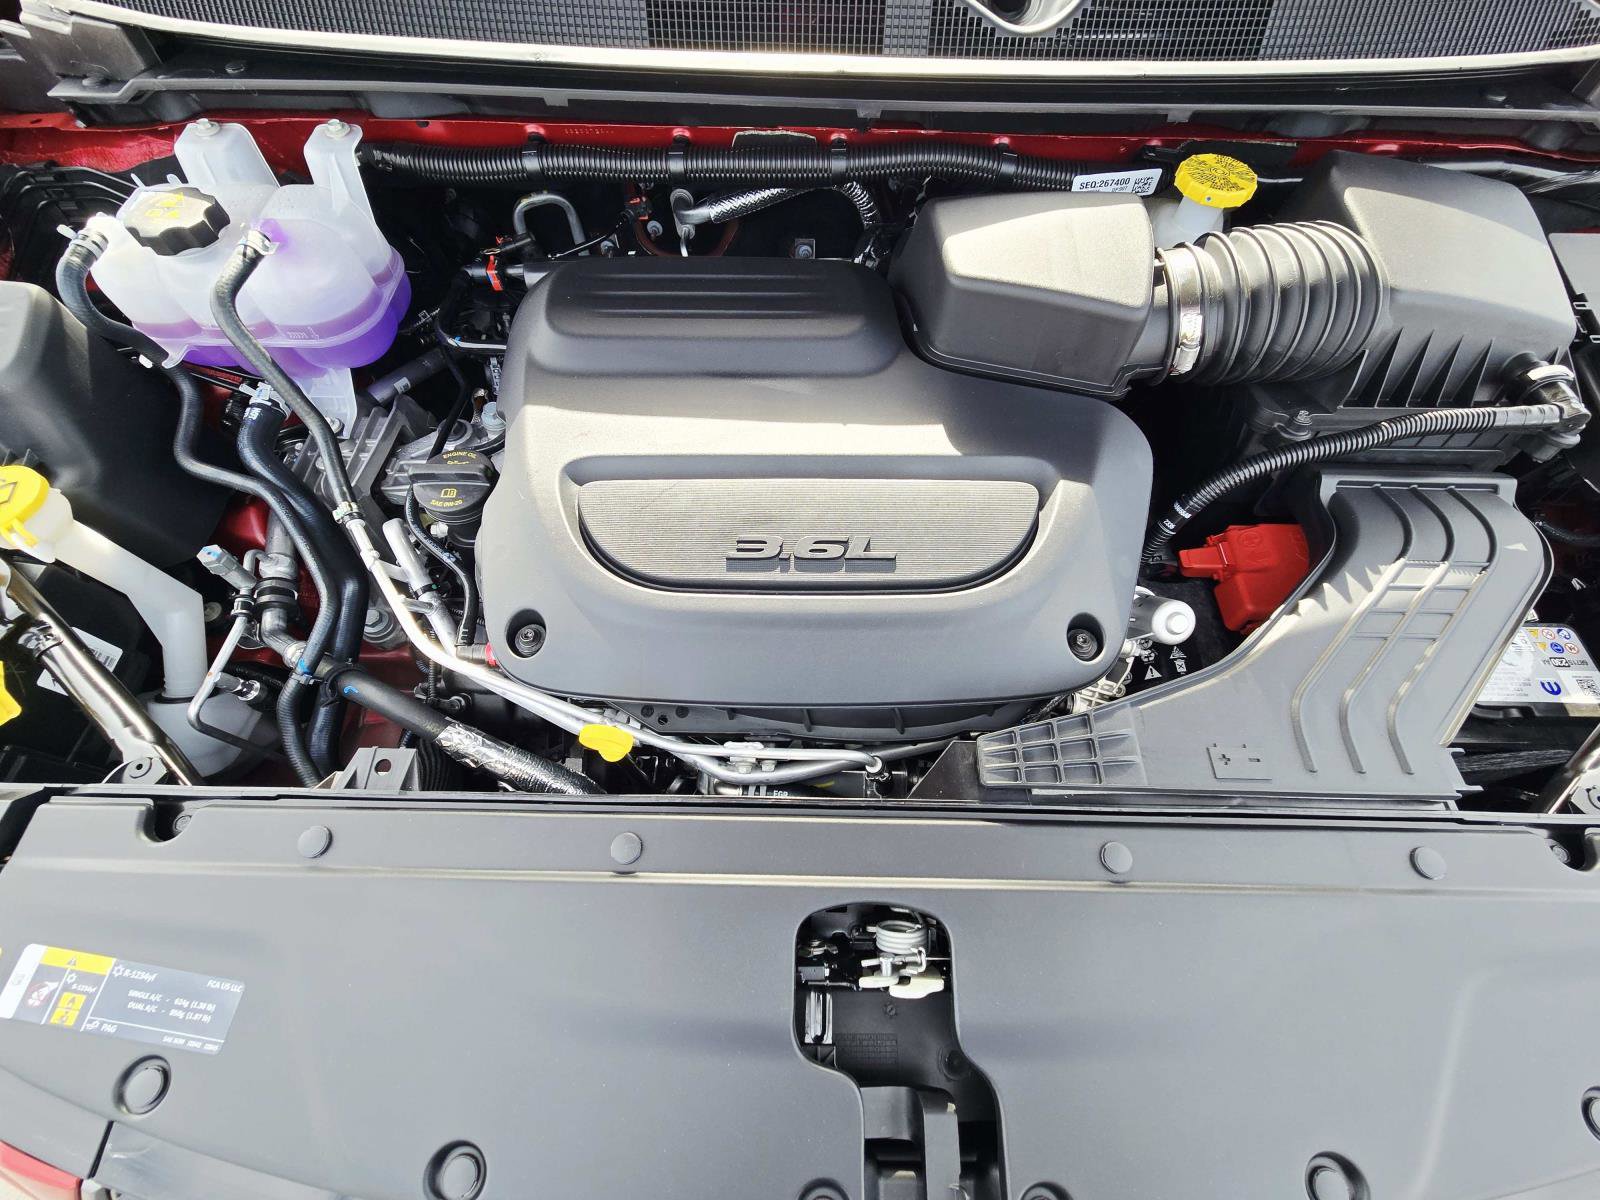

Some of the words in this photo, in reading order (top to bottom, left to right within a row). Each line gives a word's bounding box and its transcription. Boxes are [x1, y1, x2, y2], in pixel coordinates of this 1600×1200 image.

[1079, 177, 1131, 190] SEQ:267400
[442, 451, 467, 459] ENGINE
[431, 499, 443, 507] SAE
[725, 535, 898, 563] 3.6L
[122, 967, 158, 982] R-1234yf
[207, 979, 220, 989] FCA
[220, 981, 231, 990] US
[230, 983, 243, 993] LLC
[101, 1023, 118, 1033] PAG
